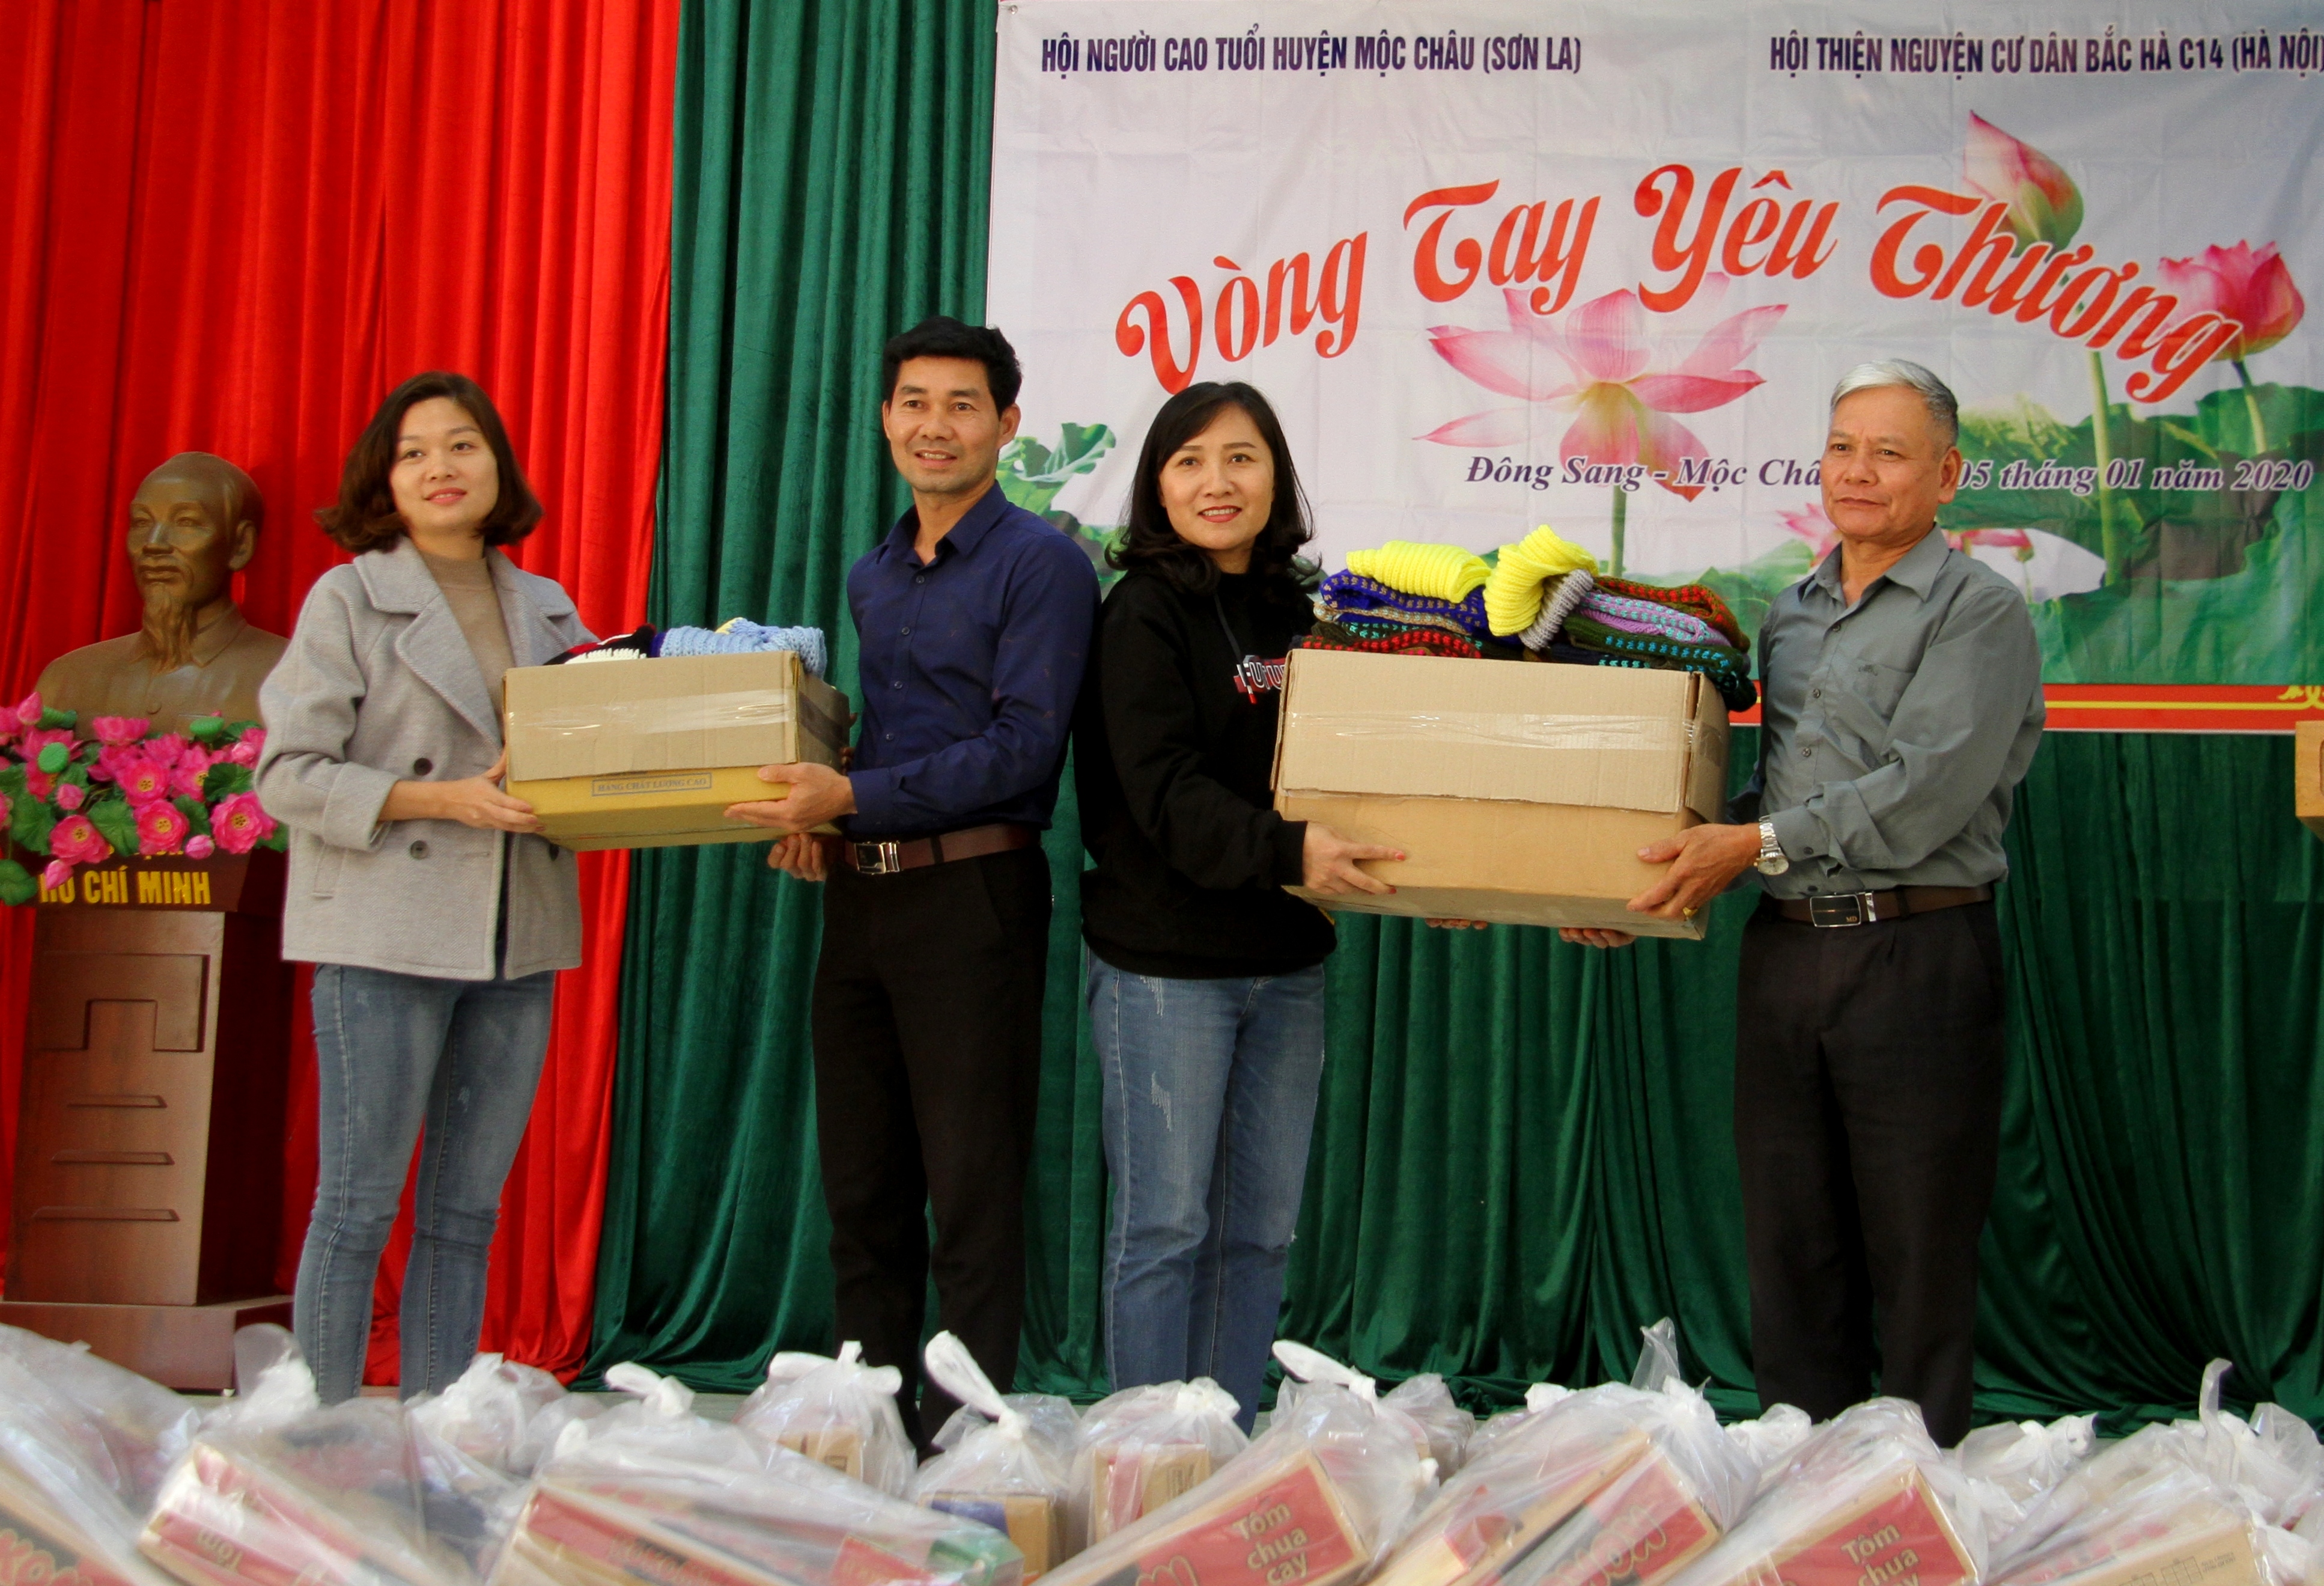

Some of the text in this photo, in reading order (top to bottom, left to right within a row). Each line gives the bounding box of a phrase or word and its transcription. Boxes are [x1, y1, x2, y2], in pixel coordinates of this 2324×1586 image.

[1042, 23, 1581, 79] HỘI NGƯỜI CAO TUỔI HUYỆN MỘC CHÂU (SƠN LA)
[1771, 29, 1808, 78] HỘI
[1816, 30, 1882, 79] THIỆN
[1890, 32, 1983, 81] NGUYỆN
[1991, 35, 2025, 73] CƯ
[2029, 31, 2078, 73] DÂN
[2085, 25, 2132, 73] BẮC
[2140, 30, 2173, 72] HÀ
[2179, 37, 2224, 70] C14
[2231, 28, 2272, 73] (HÀ
[1116, 163, 2243, 403] Vòng Tay Yêu Thương
[1466, 456, 1554, 490] Đông
[1562, 457, 1645, 490] Sang
[1676, 459, 1747, 492] Mộc
[1758, 459, 1821, 486] Châ
[1998, 459, 2096, 494] tháng
[2105, 459, 2142, 488] 01
[2152, 460, 2222, 489] năm
[2230, 460, 2312, 489] 2020
[84, 865, 129, 904] CHÍ
[137, 871, 211, 904] MINH
[1233, 1502, 1291, 1541] Tôm
[1246, 1527, 1309, 1570] chua
[1840, 1523, 1902, 1566] Tôm
[1266, 1551, 1308, 1585] cay
